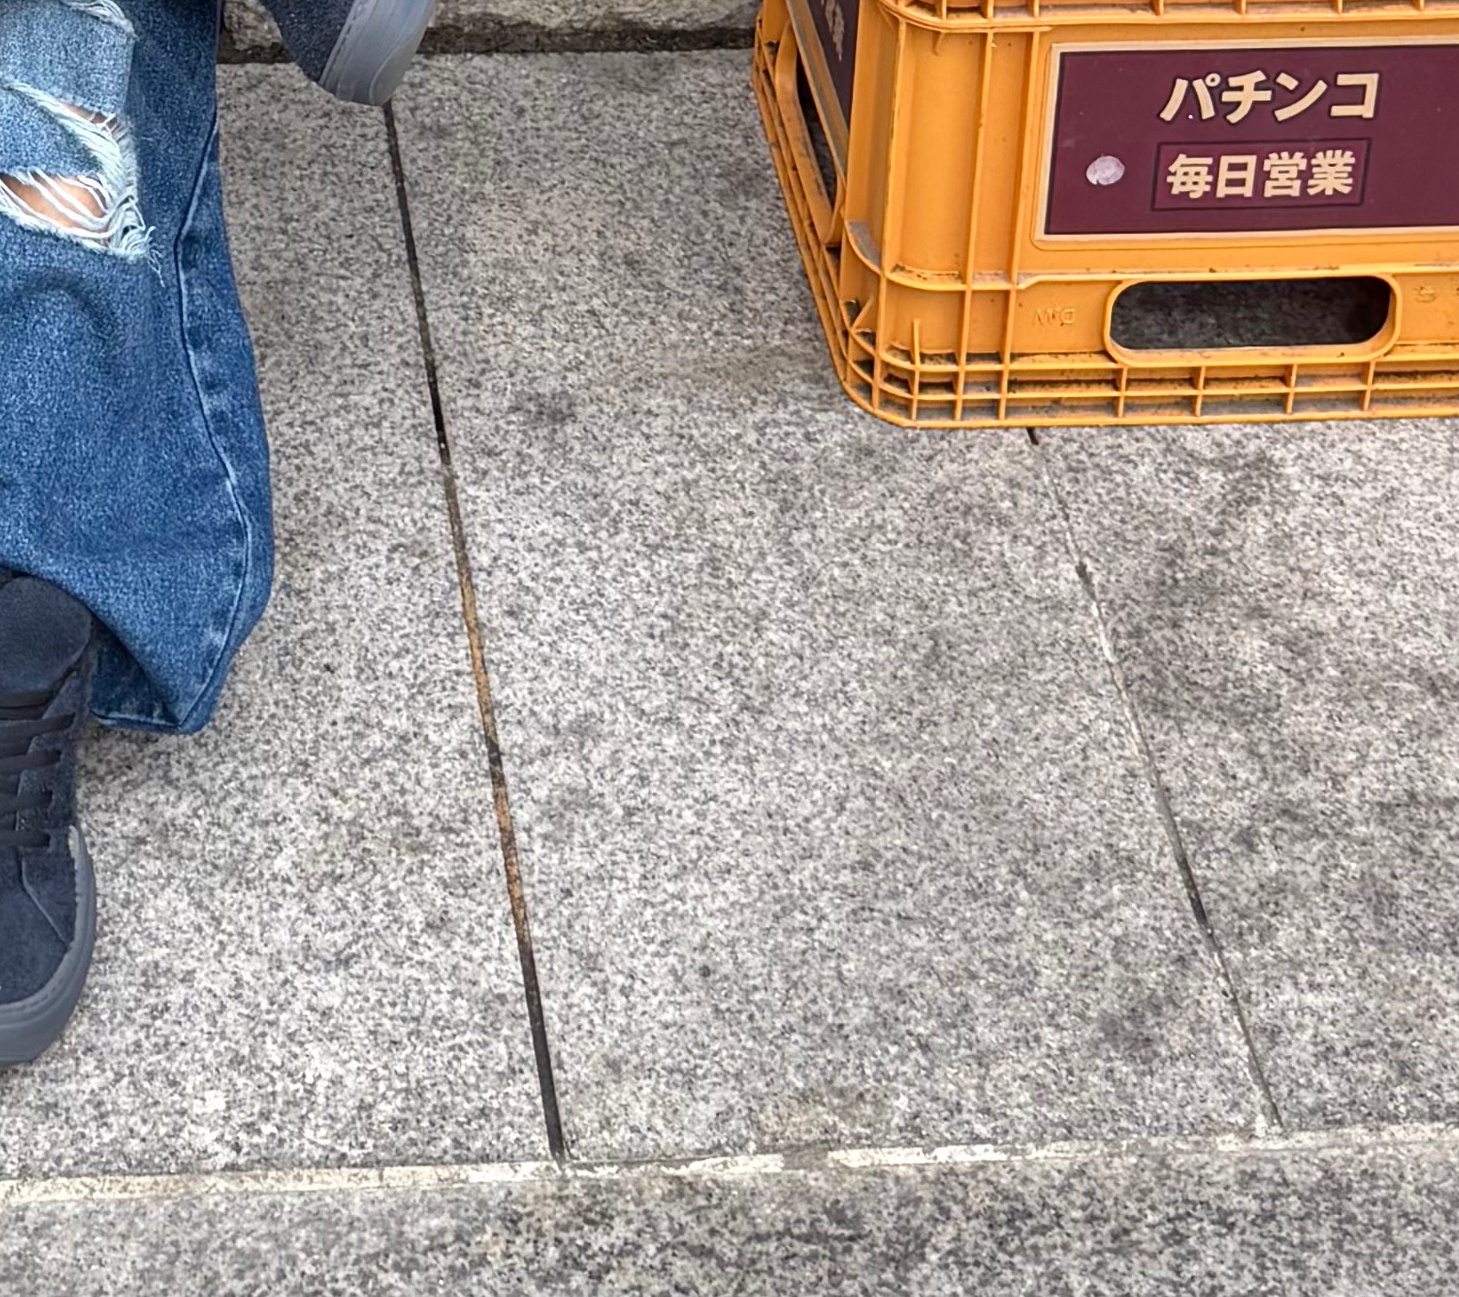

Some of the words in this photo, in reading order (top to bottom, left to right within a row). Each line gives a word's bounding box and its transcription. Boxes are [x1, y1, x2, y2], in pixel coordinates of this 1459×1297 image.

[1159, 70, 1379, 123] パチンコ
[1166, 150, 1355, 199] 毎日営業
